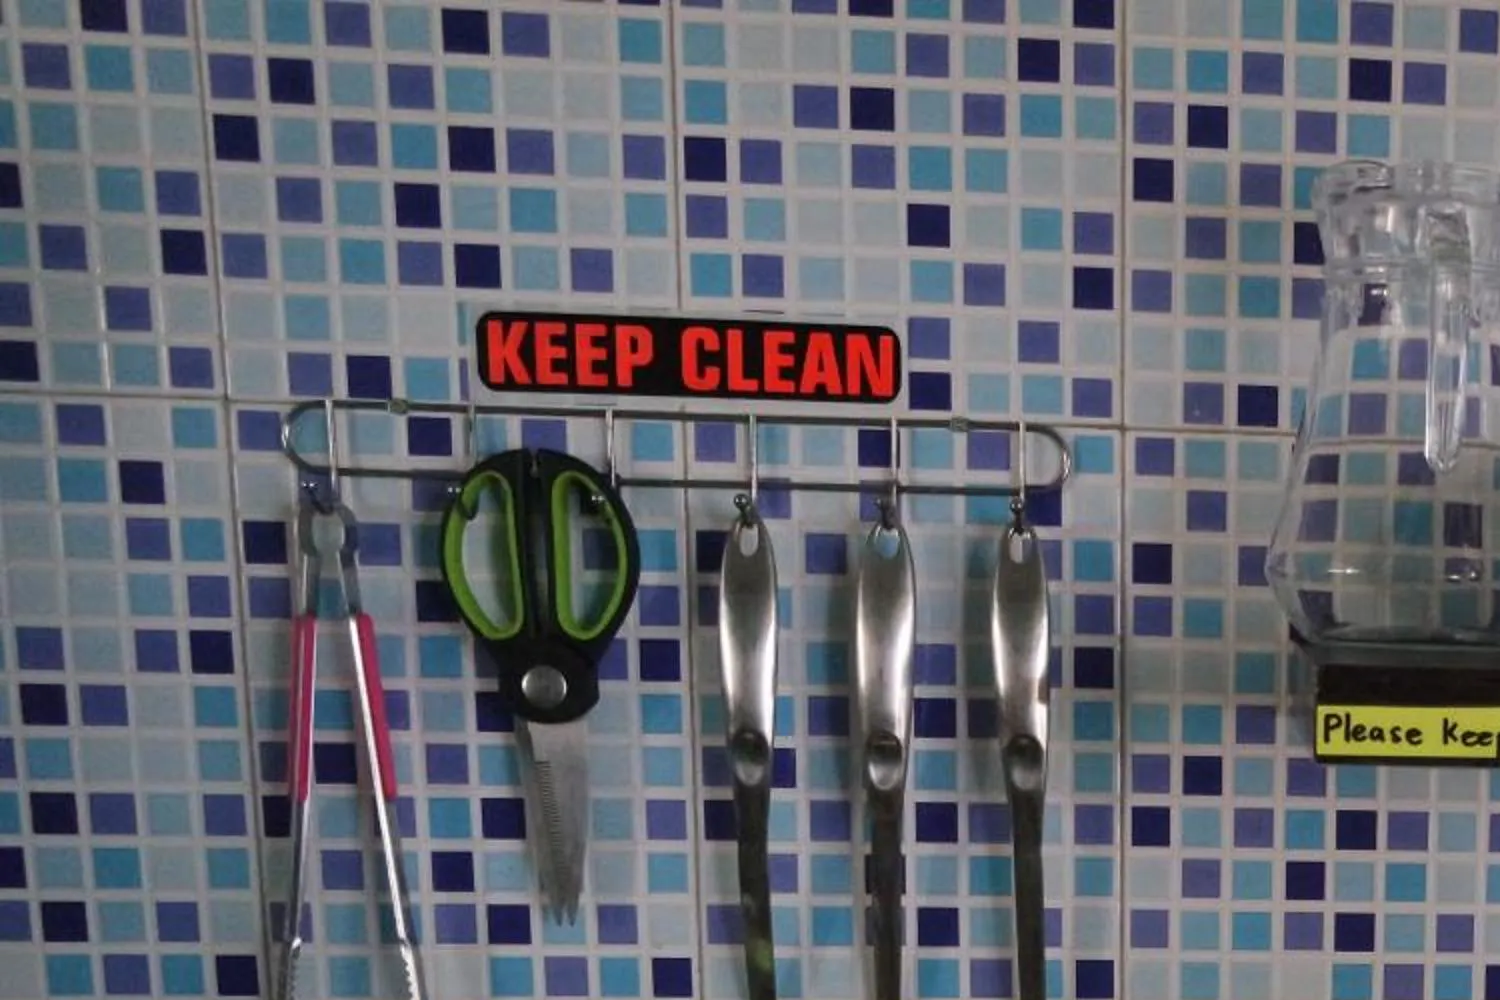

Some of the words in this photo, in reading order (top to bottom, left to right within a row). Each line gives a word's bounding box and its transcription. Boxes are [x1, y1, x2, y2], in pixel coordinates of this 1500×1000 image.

[486, 319, 654, 388] KEEP
[681, 326, 894, 397] CLEAN
[1322, 713, 1423, 746] Please
